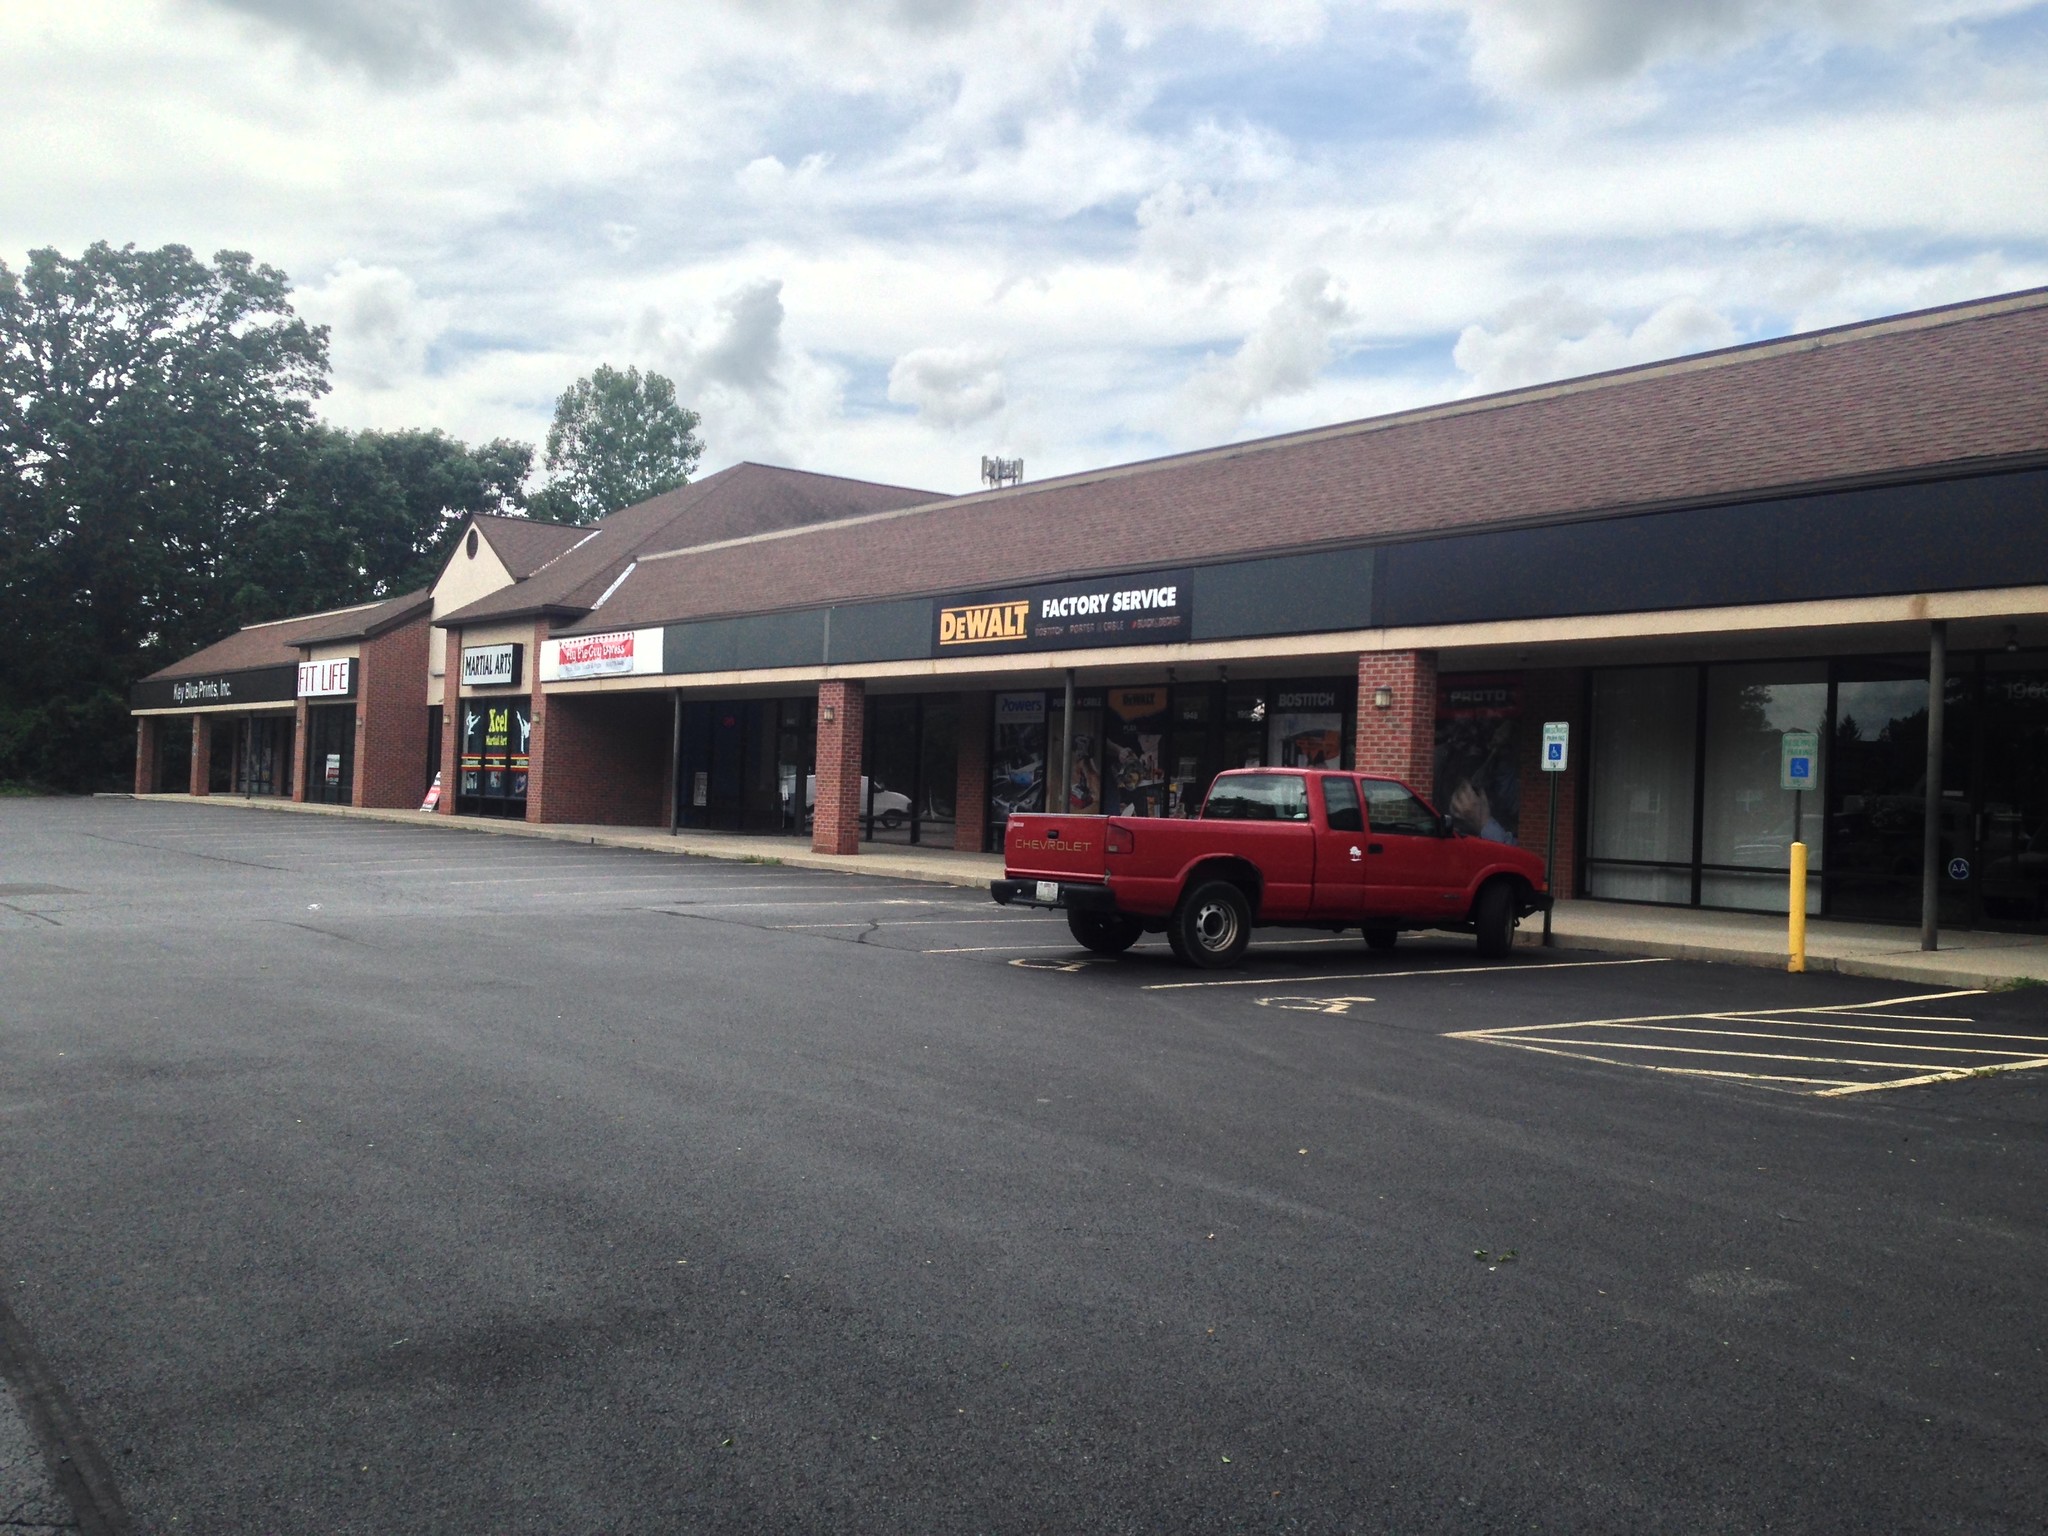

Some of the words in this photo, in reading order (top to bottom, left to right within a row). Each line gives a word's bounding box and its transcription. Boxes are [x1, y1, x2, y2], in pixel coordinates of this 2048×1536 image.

[1042, 594, 1110, 618] FACTORY
[1112, 587, 1177, 612] SERVICE
[299, 665, 318, 692] FIT
[321, 662, 348, 691] LIFE
[465, 654, 492, 677] MARTIAL
[494, 653, 511, 675] ARTS
[173, 683, 184, 704] Key
[185, 682, 198, 699] Blue
[198, 680, 219, 700] Prints,
[220, 678, 231, 697] Inc.
[1278, 692, 1335, 707] BOSTITCH
[1450, 689, 1507, 702] PROTO
[1001, 698, 1043, 712] Powers
[488, 708, 508, 733] Xcel
[1015, 839, 1092, 852] CHEVROLET
